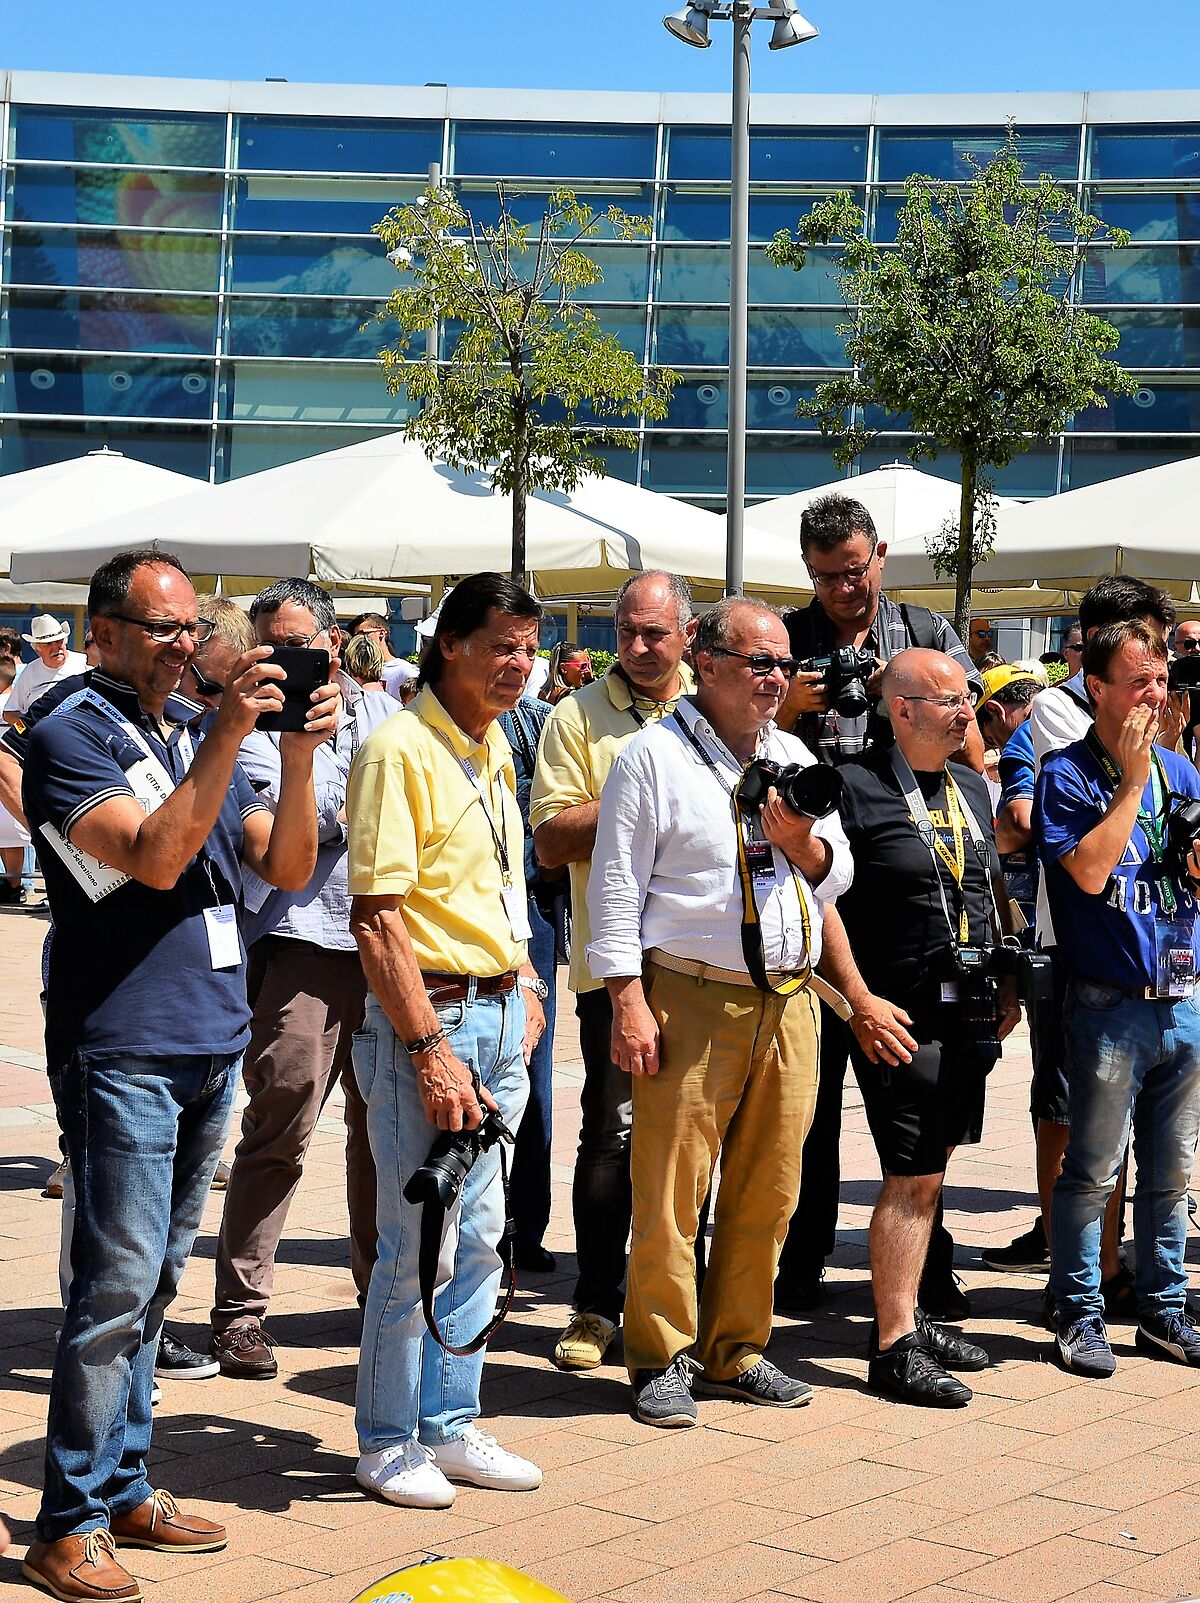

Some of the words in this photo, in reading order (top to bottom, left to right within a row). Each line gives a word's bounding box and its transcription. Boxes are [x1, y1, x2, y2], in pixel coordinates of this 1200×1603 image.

[1101, 757, 1118, 778] Nikon
[145, 772, 163, 792] CITTA'
[64, 840, 75, 854] San
[72, 853, 98, 887] Sebastiano
